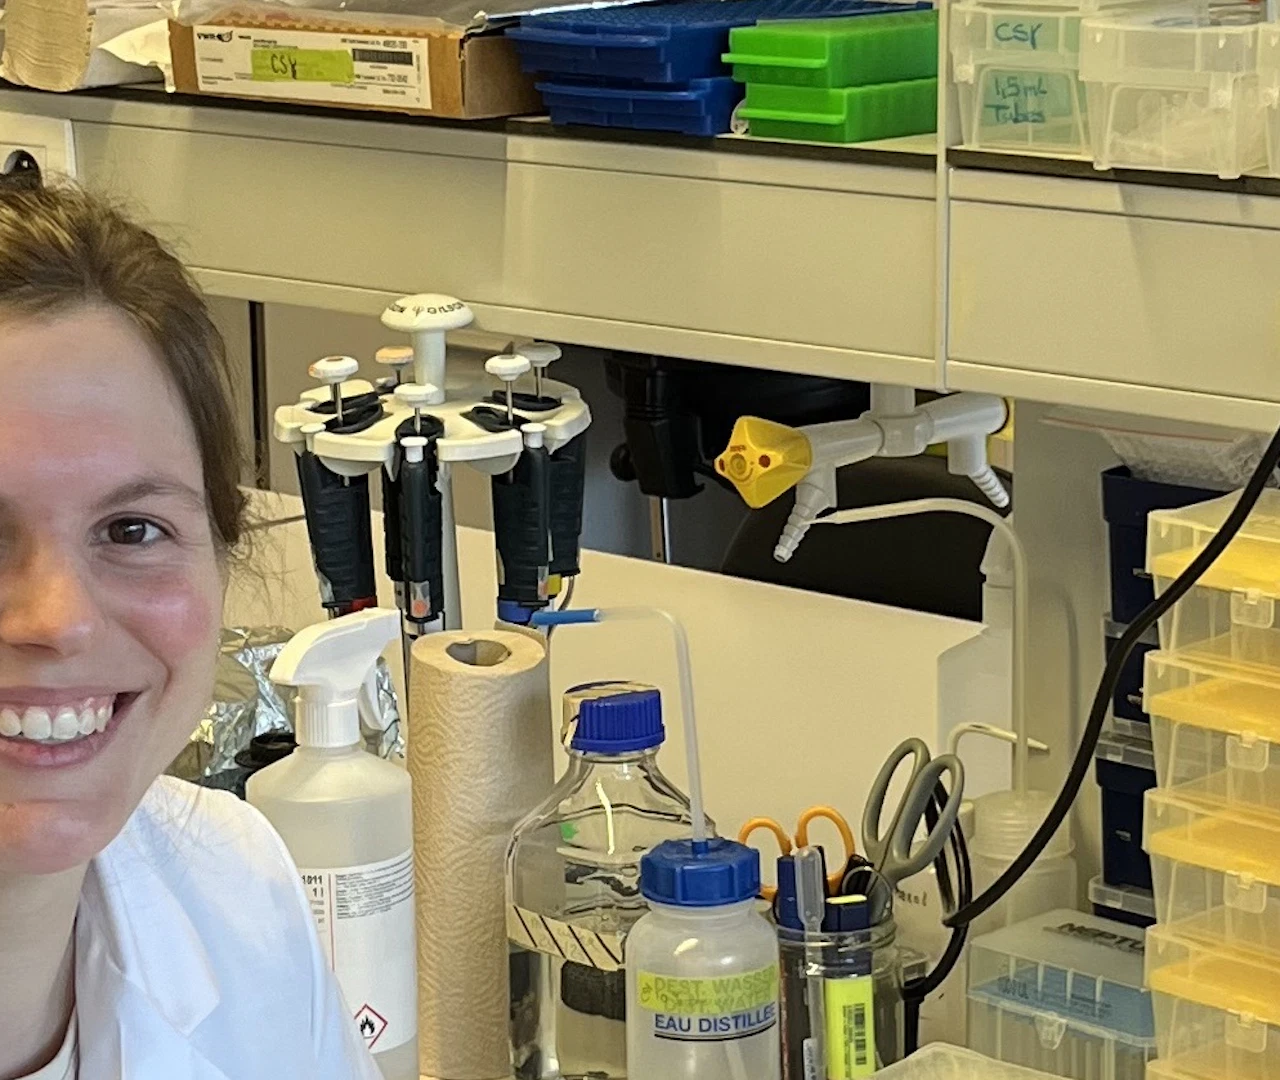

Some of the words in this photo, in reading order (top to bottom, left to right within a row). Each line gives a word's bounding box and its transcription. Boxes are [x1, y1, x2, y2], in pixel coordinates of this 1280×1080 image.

[995, 22, 1043, 49] CSY
[271, 54, 297, 79] CSY
[654, 1013, 692, 1033] EAU
